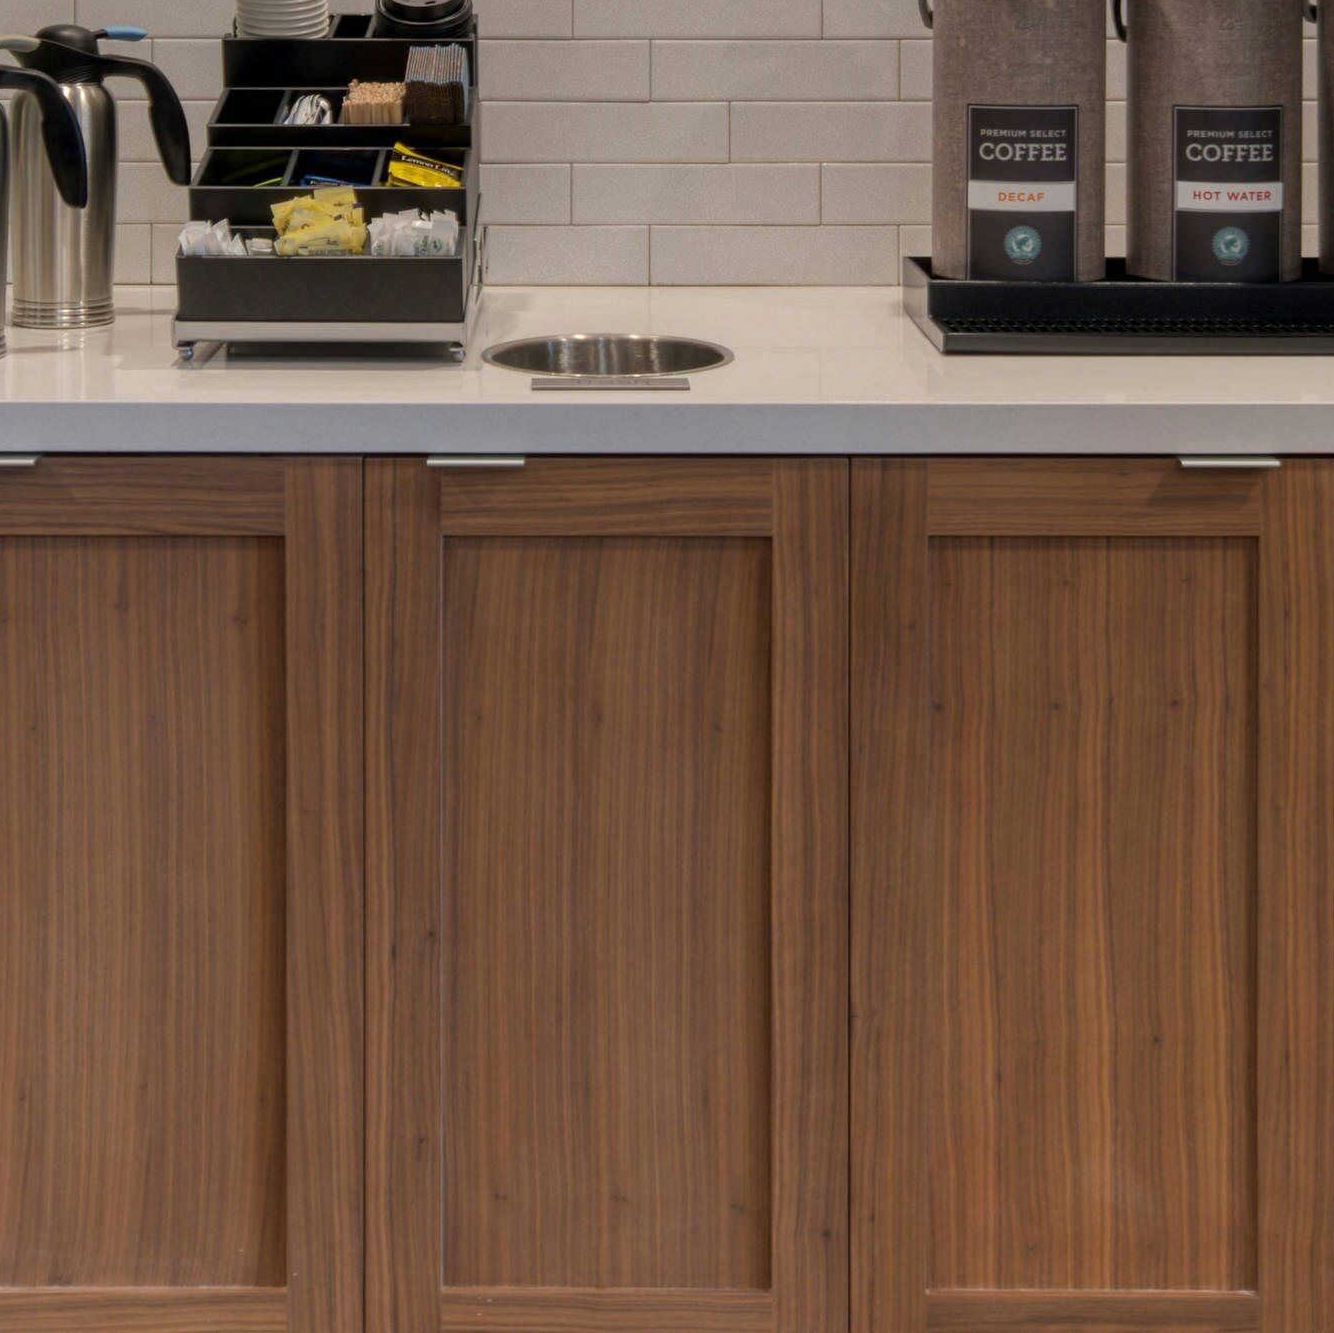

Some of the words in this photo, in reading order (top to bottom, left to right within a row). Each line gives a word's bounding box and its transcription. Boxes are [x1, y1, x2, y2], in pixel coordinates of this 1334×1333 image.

[980, 129, 1027, 138] PREMIUM
[1030, 129, 1067, 138] SELECT
[1186, 129, 1235, 139] PREMIUM
[1238, 130, 1273, 139] SELECT
[979, 142, 1067, 162] COFFEE
[1185, 143, 1274, 162] COFFEE
[998, 191, 1045, 202] DECAF
[1192, 190, 1222, 201] HOT
[1227, 191, 1272, 202] WATER
